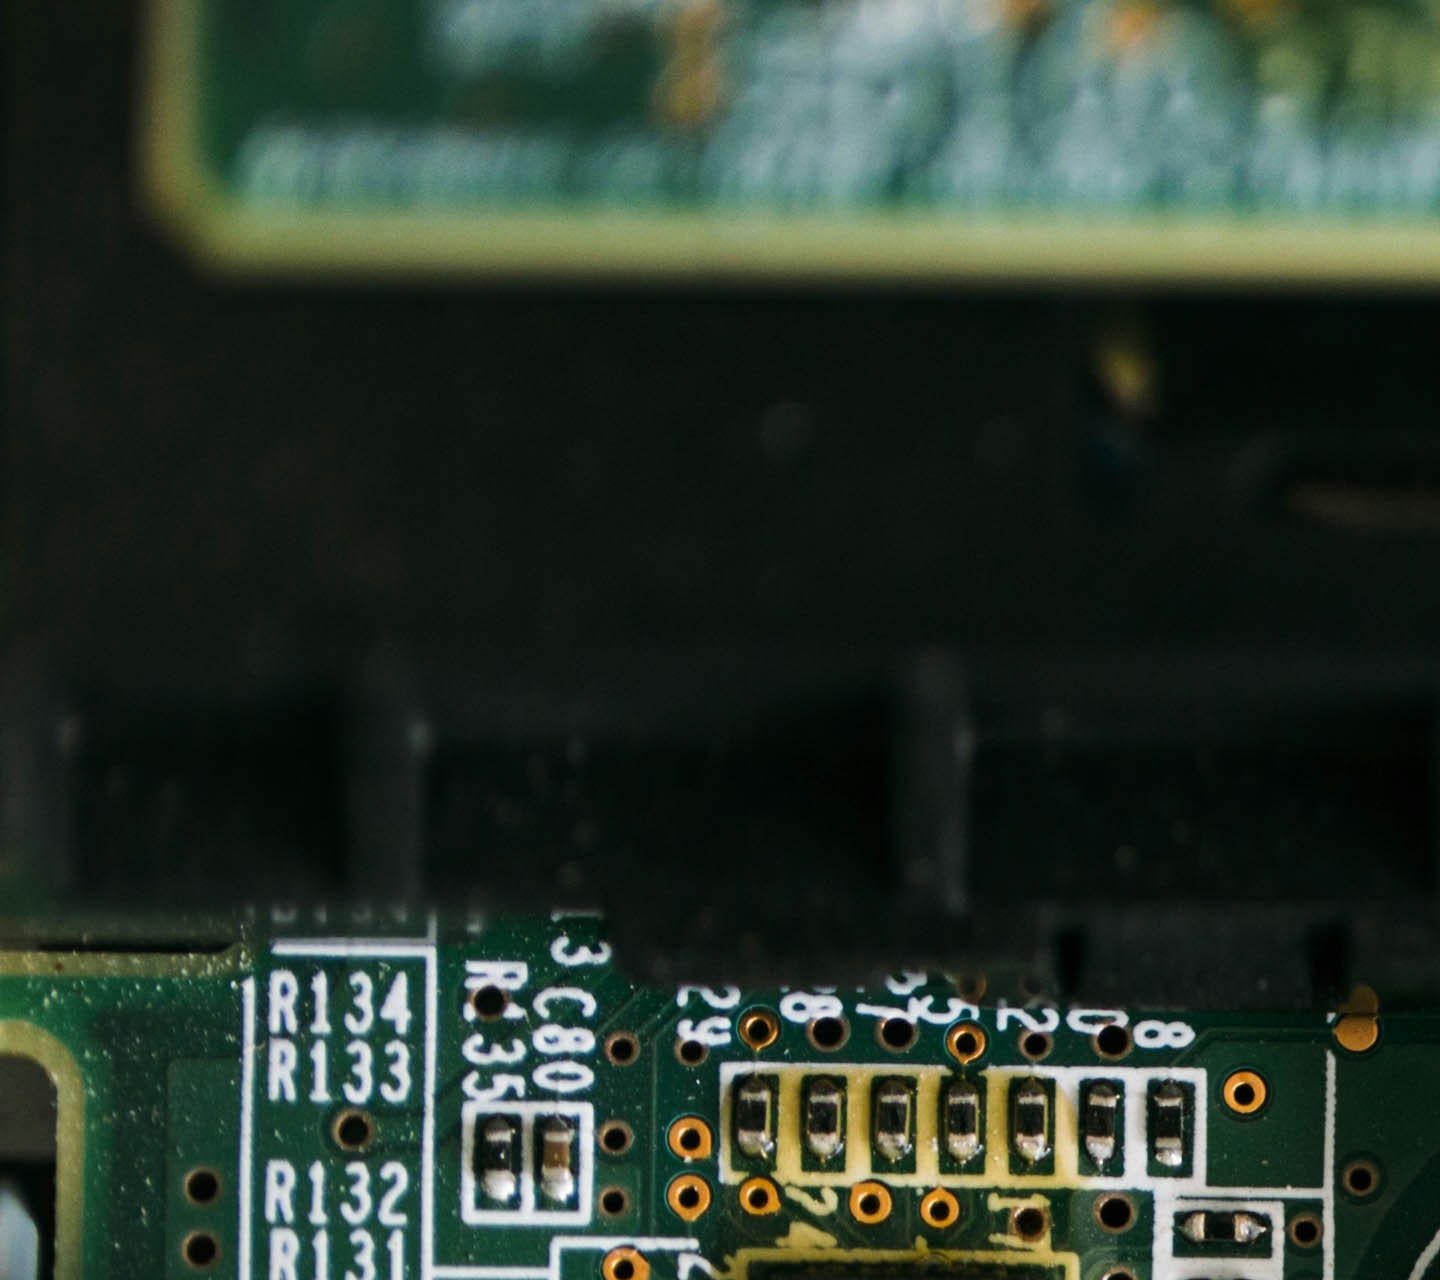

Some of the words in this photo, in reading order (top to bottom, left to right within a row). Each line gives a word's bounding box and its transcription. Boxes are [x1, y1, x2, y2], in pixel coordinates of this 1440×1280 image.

[269, 970, 410, 1036] R134
[269, 1038, 410, 1103] R133
[532, 987, 596, 1093] C80
[266, 1161, 408, 1224] R132
